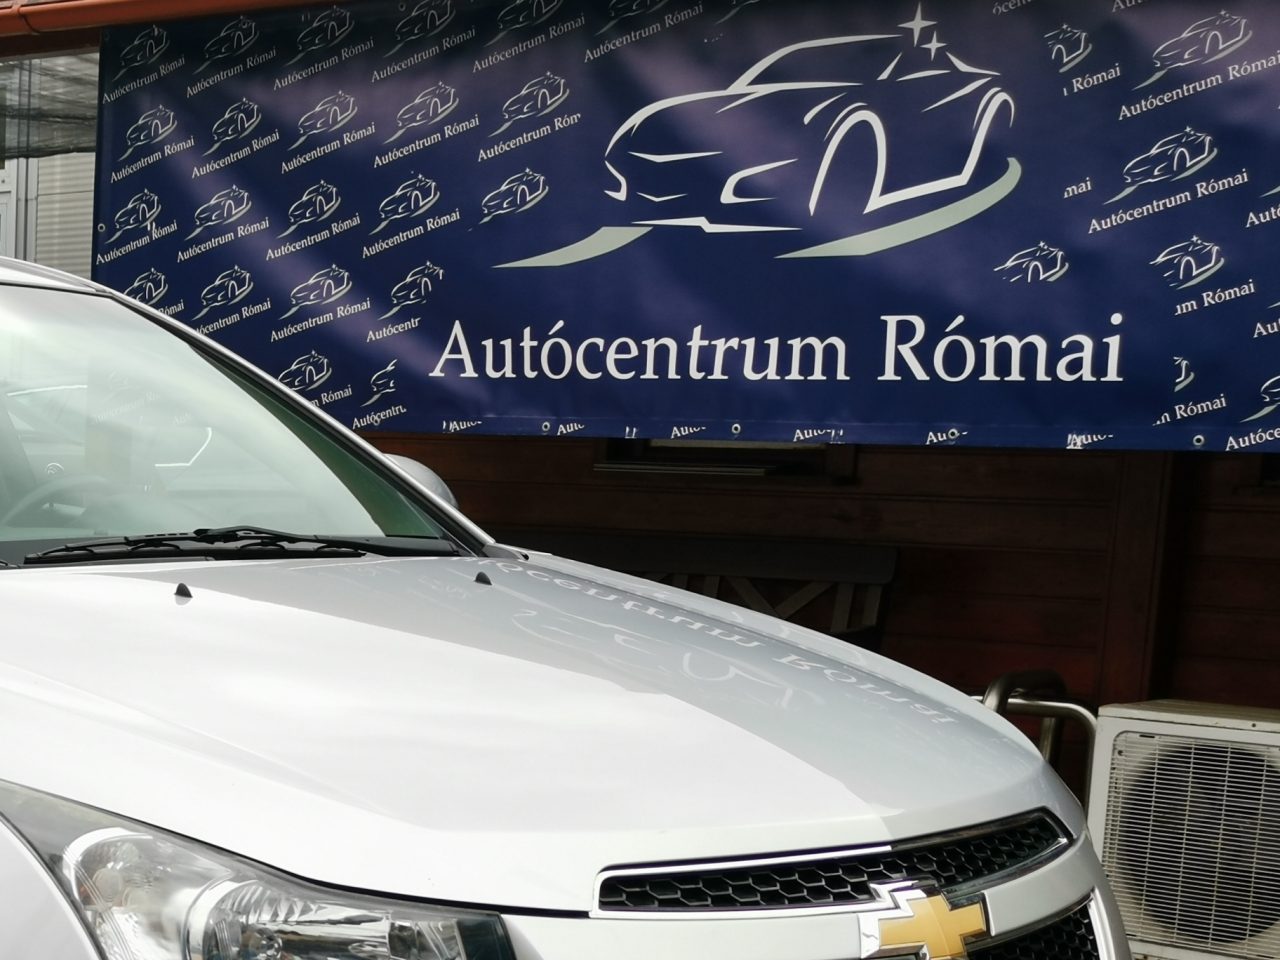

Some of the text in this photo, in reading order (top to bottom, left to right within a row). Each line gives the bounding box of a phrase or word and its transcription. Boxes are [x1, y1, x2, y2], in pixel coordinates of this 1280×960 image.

[371, 25, 476, 82] Autócentrum Római
[472, 13, 586, 73] Autócentrum Római
[584, 0, 704, 63] Autócentrum Római
[102, 54, 186, 104] Autócentrum Római
[186, 47, 277, 98] Autócentrum Római
[273, 36, 375, 91] Autócentrum Római
[1072, 62, 1121, 93] Római
[1118, 49, 1280, 121] Autócentrum Római
[110, 136, 195, 184] Autócentrum Római
[191, 129, 280, 179] Autócentrum Római
[280, 122, 376, 174] Autócentrum Római
[373, 114, 480, 168] Autócentrum Római
[477, 124, 551, 162] Autócentrum
[1088, 168, 1249, 234] Autócentrum Római
[96, 235, 150, 265] Autócentrum
[177, 217, 269, 263] Autócentrum Római
[266, 213, 361, 261] Autócentrum Római
[361, 208, 461, 259] Autócentrum Római
[242, 298, 271, 319] Római
[1202, 279, 1256, 307] Római
[270, 298, 370, 342] Autócentrum Római
[428, 313, 1124, 382] Autócentrum Római
[320, 384, 353, 405] Római
[1174, 393, 1227, 420] Római
